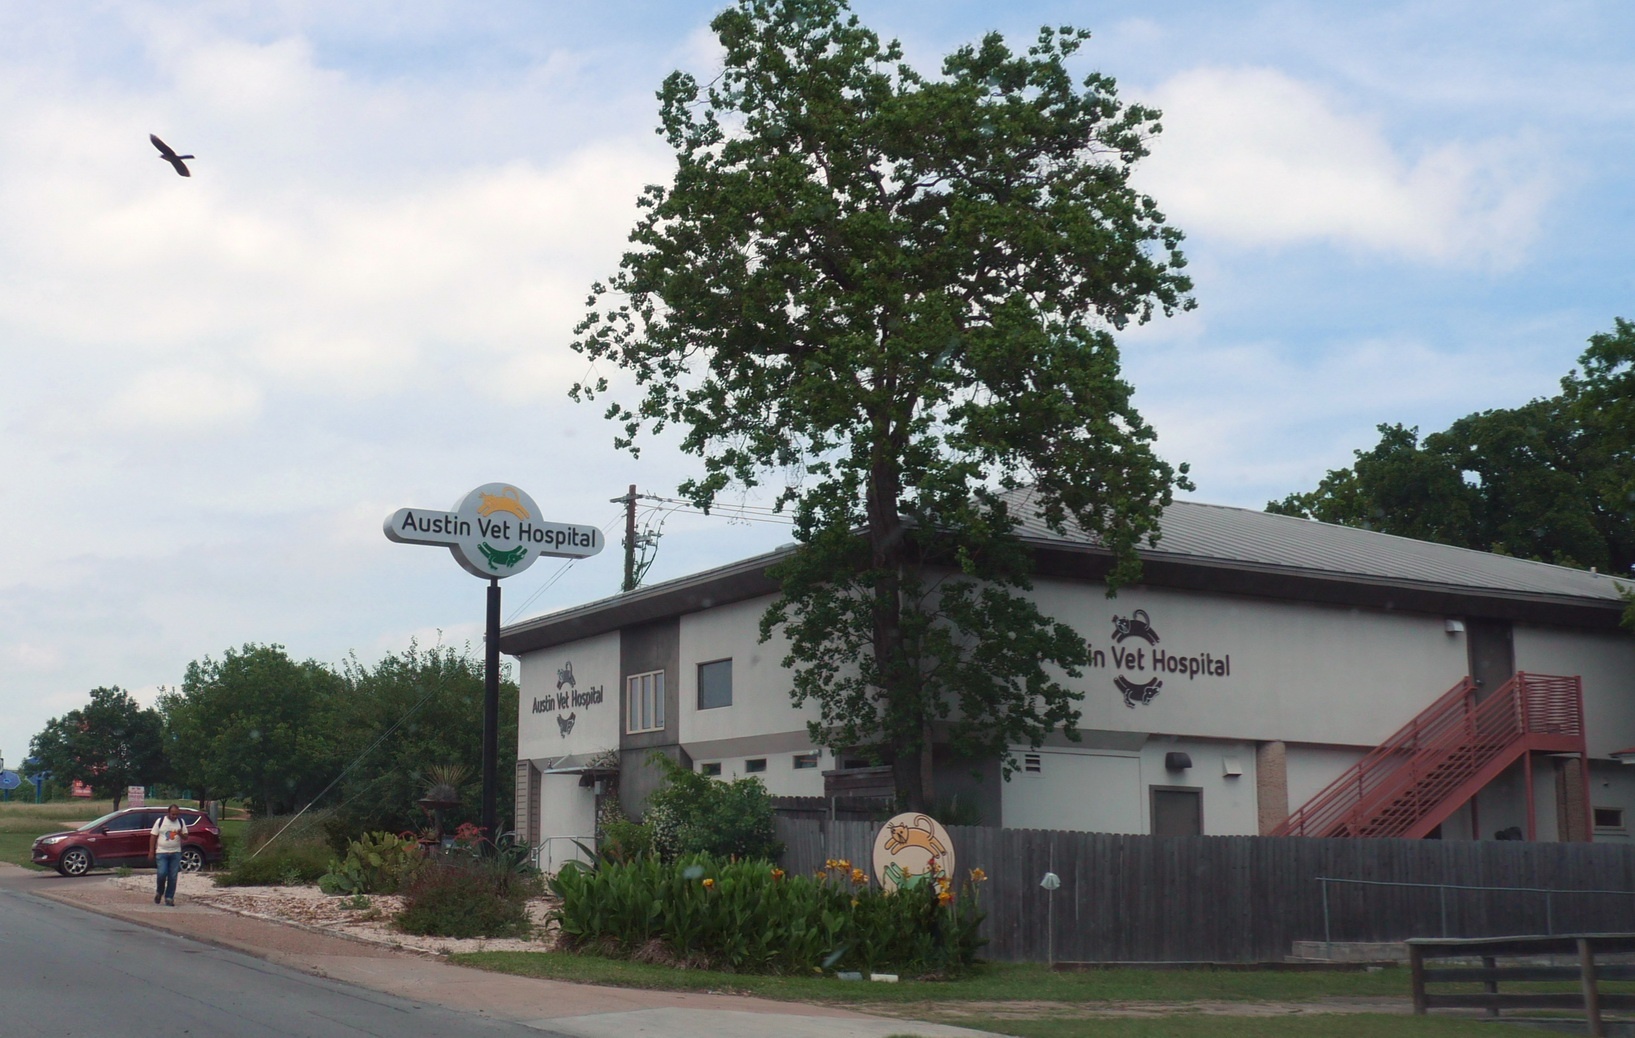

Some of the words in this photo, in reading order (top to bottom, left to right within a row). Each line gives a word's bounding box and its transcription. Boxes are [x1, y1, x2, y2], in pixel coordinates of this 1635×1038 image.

[402, 511, 470, 536] Austin
[478, 518, 510, 540] Vet
[519, 523, 596, 549] Hospital
[1111, 645, 1145, 671] Vet
[1152, 649, 1230, 680] Hospital
[532, 695, 555, 714] Austin
[556, 691, 569, 709] Vet
[571, 685, 603, 710] Hospital
